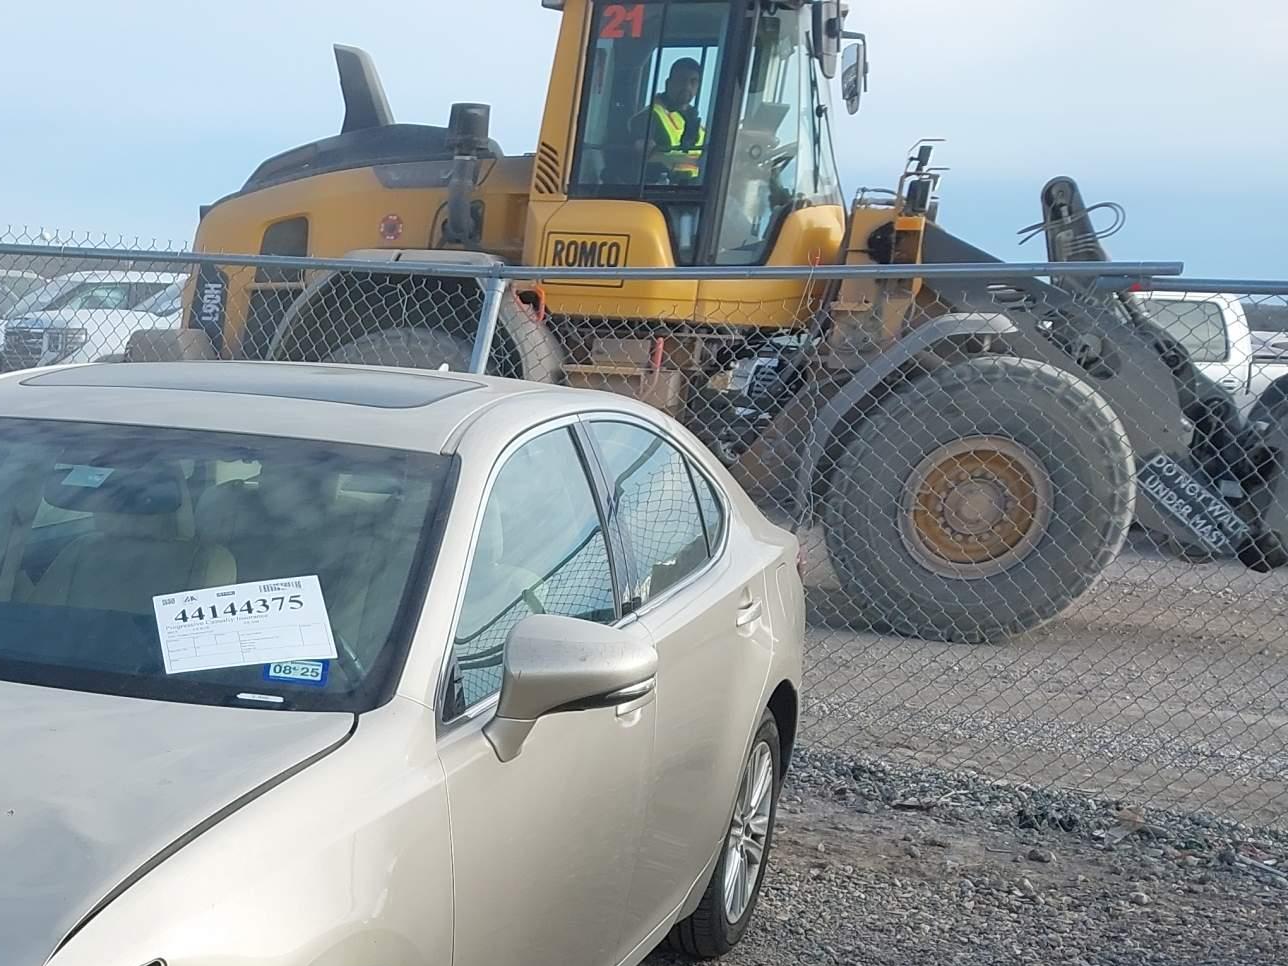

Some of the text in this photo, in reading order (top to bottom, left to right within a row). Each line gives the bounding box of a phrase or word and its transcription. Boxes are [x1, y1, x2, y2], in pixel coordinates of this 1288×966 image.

[599, 4, 645, 38] 21
[552, 239, 621, 268] ROMCO
[201, 283, 222, 321] L90H
[1145, 475, 1227, 548] UNDER MAST
[1152, 455, 1249, 539] DO NOT WALK
[174, 594, 304, 623] 44144375
